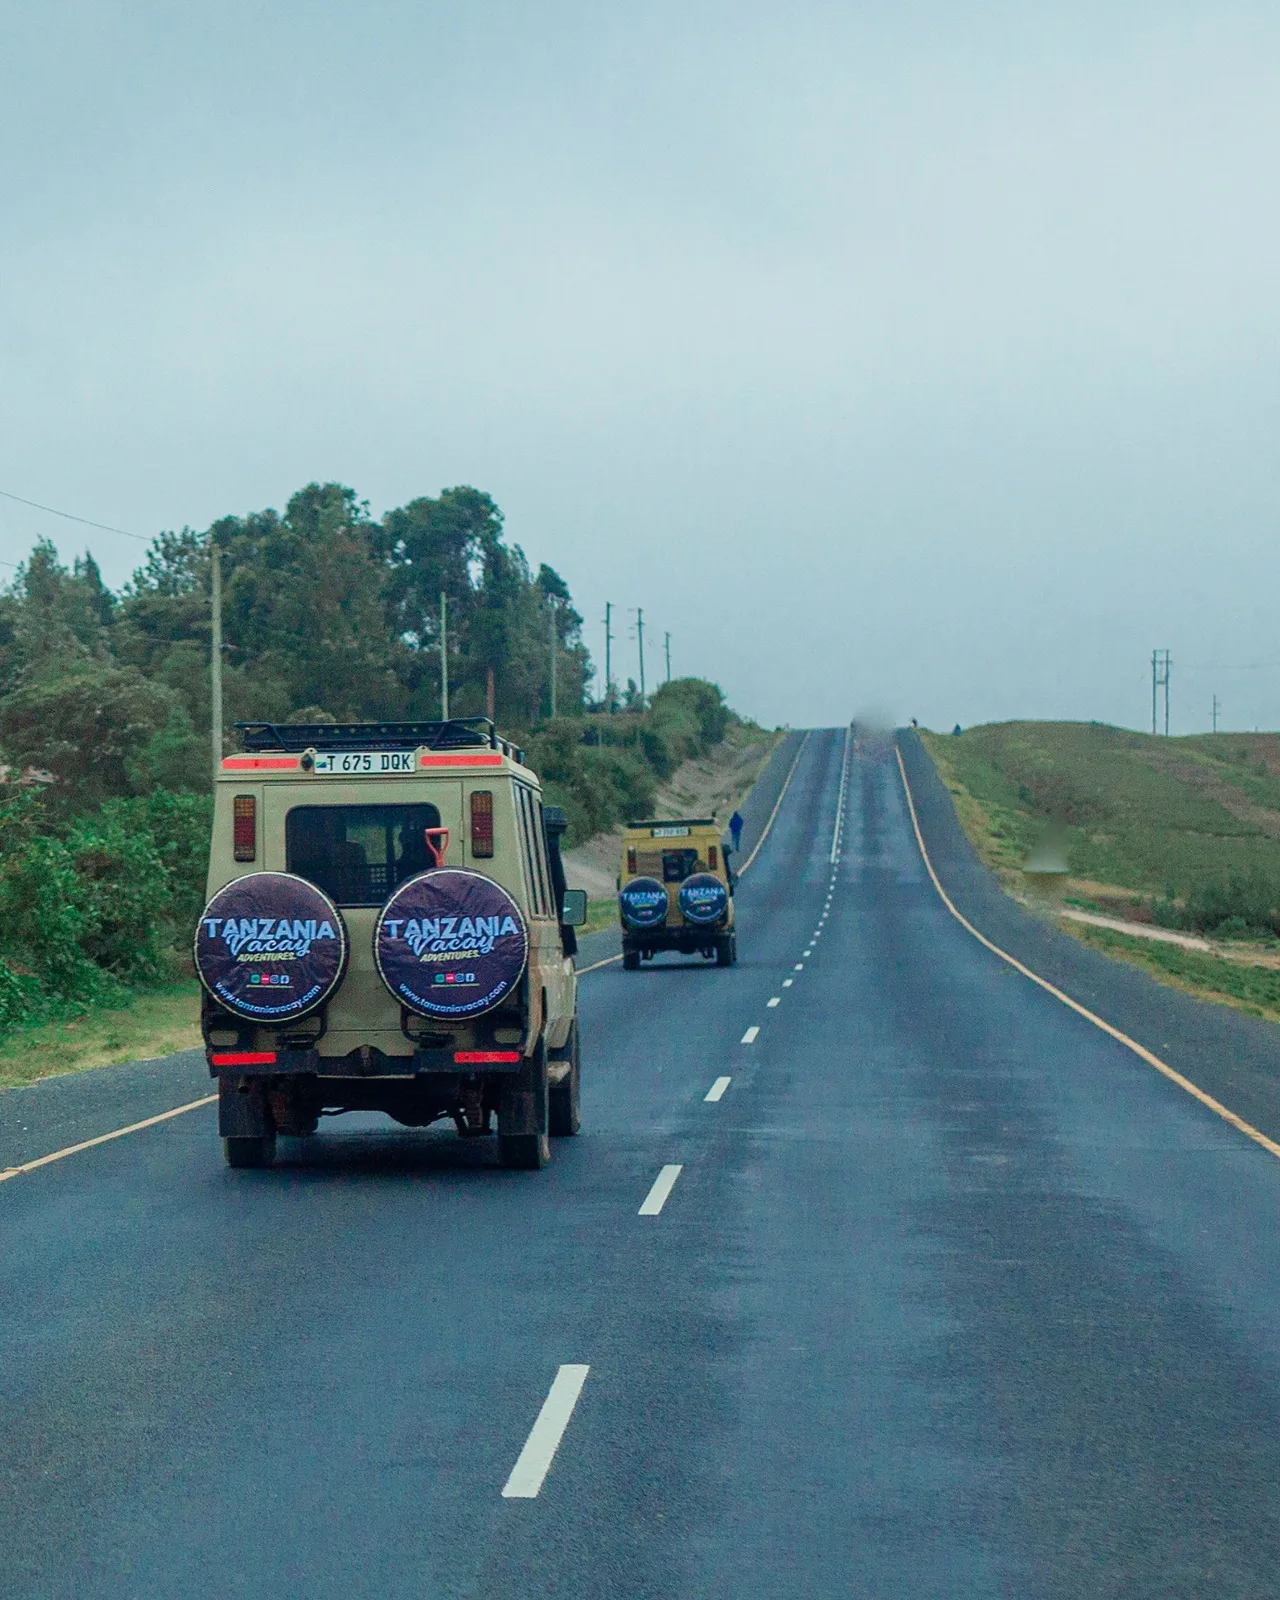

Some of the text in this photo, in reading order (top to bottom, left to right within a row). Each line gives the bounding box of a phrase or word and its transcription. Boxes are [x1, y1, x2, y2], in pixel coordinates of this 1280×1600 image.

[327, 754, 411, 771] T 675 DQK
[203, 918, 336, 940] TANZANIA
[383, 916, 519, 939] TANZANIA
[225, 933, 311, 957] Vacay
[408, 934, 495, 956] Vacay
[215, 982, 321, 1014] www.tanzaniavacay.com
[399, 980, 508, 1013] www.tanzaniavacay.com
